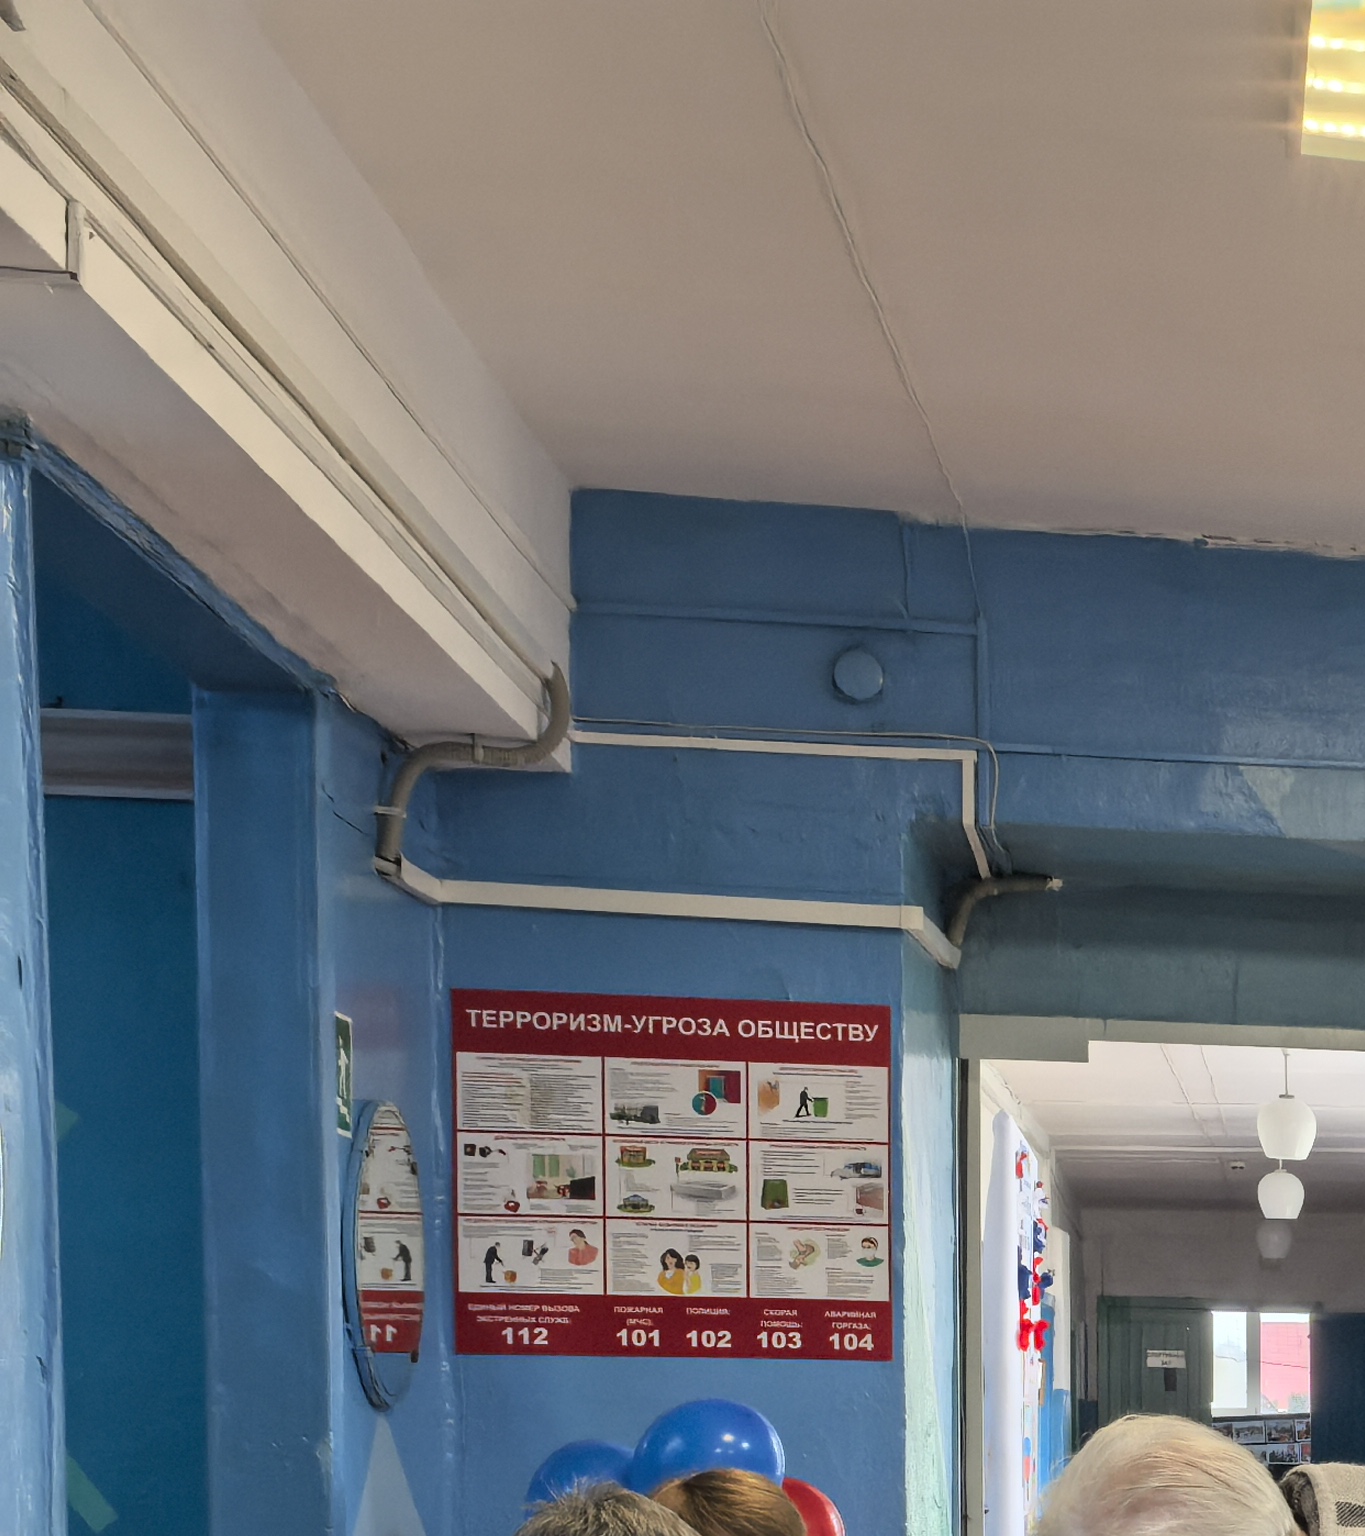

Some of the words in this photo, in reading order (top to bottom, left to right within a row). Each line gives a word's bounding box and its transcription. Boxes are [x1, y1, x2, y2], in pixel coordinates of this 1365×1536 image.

[466, 1009, 730, 1037] ТЕРРОРИЗМ-УГРОЗА
[738, 1019, 878, 1042] ОБЩЕСТВУ
[542, 1304, 580, 1313] ВЫЗОВА
[614, 1306, 664, 1314] ПОЖАРНАЯ
[763, 1308, 798, 1316] СКОРАЯ
[501, 1327, 549, 1345] 112
[616, 1329, 660, 1347] 101
[686, 1330, 732, 1348] 102
[756, 1331, 802, 1349] 103
[829, 1333, 875, 1351] 104
